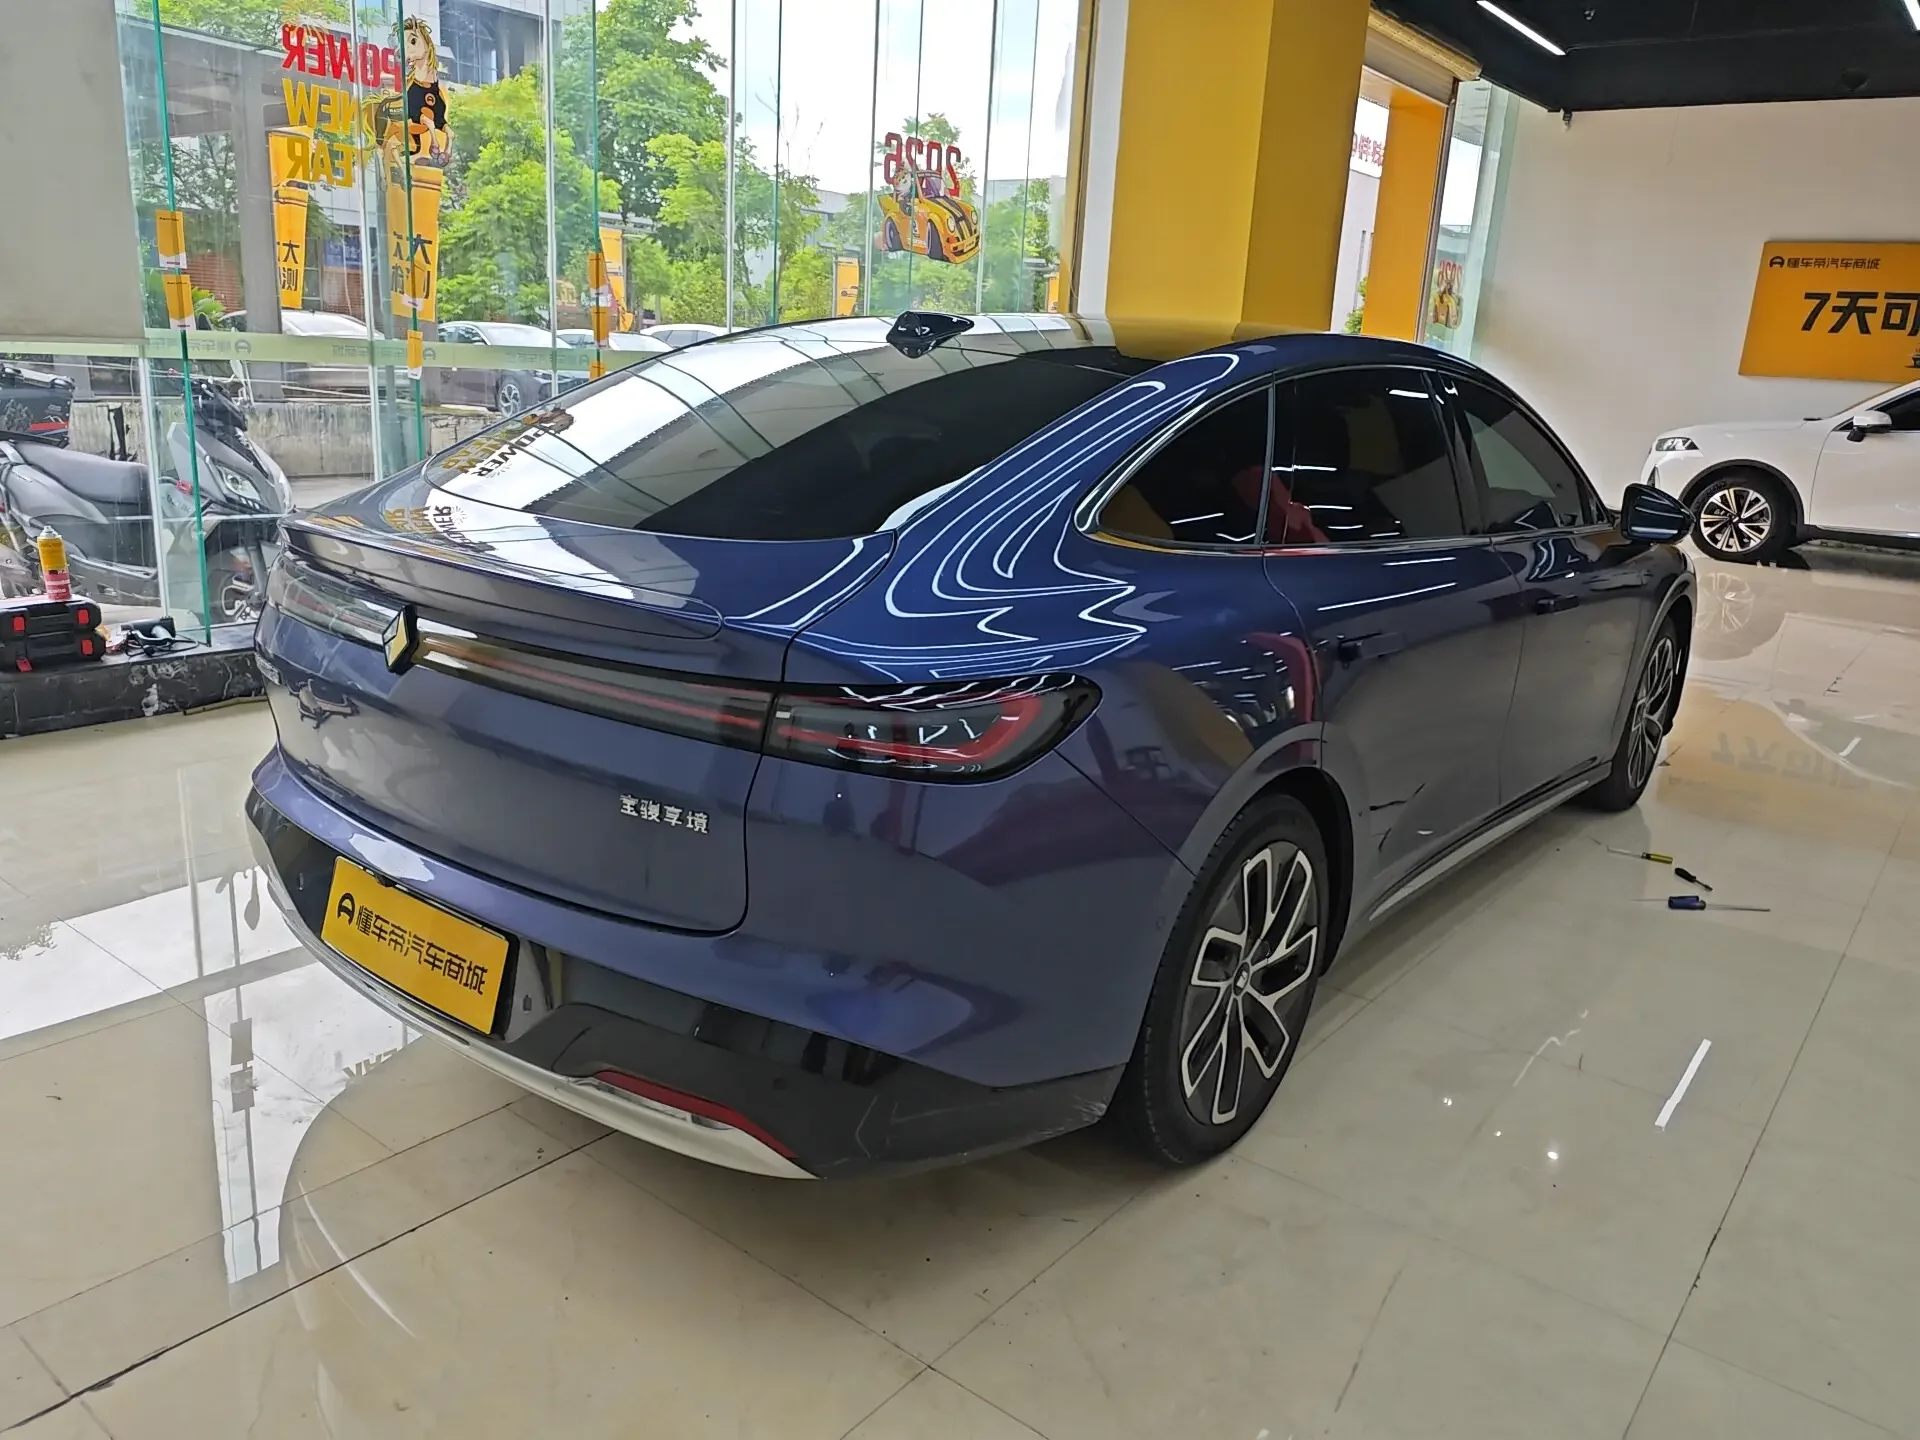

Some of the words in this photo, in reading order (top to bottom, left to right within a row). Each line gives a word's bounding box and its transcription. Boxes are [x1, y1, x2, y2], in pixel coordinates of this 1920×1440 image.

[1787, 257, 1881, 270] 懂车帝汽车商城
[1801, 291, 1920, 337] 7天可
[620, 794, 708, 834] 宝骏享境
[355, 905, 488, 995] 懂车帝汽车商城
